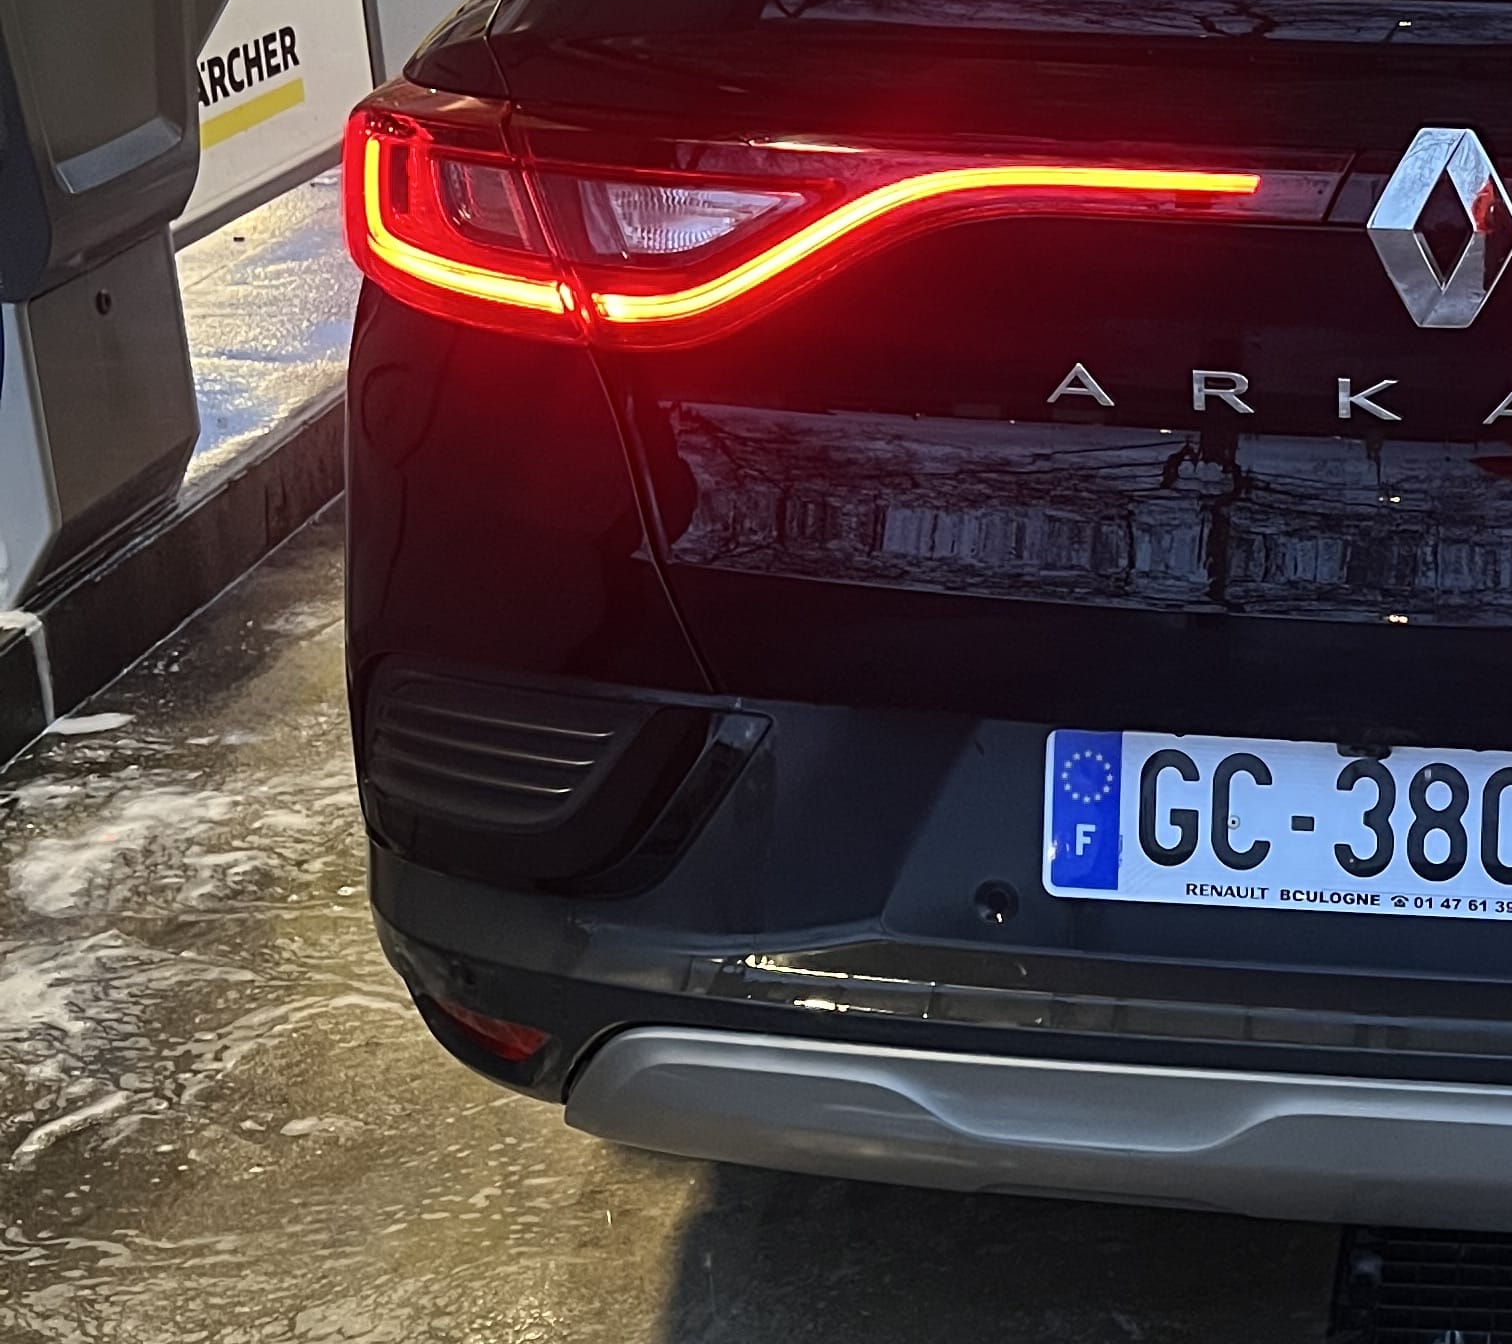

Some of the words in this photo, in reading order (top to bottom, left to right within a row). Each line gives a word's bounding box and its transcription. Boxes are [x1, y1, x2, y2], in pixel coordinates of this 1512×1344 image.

[1075, 823, 1096, 856] F
[1186, 883, 1269, 900] RENAULT
[1414, 896, 1433, 909] 01
[1440, 898, 1462, 911] 47
[1468, 899, 1487, 912] 61
